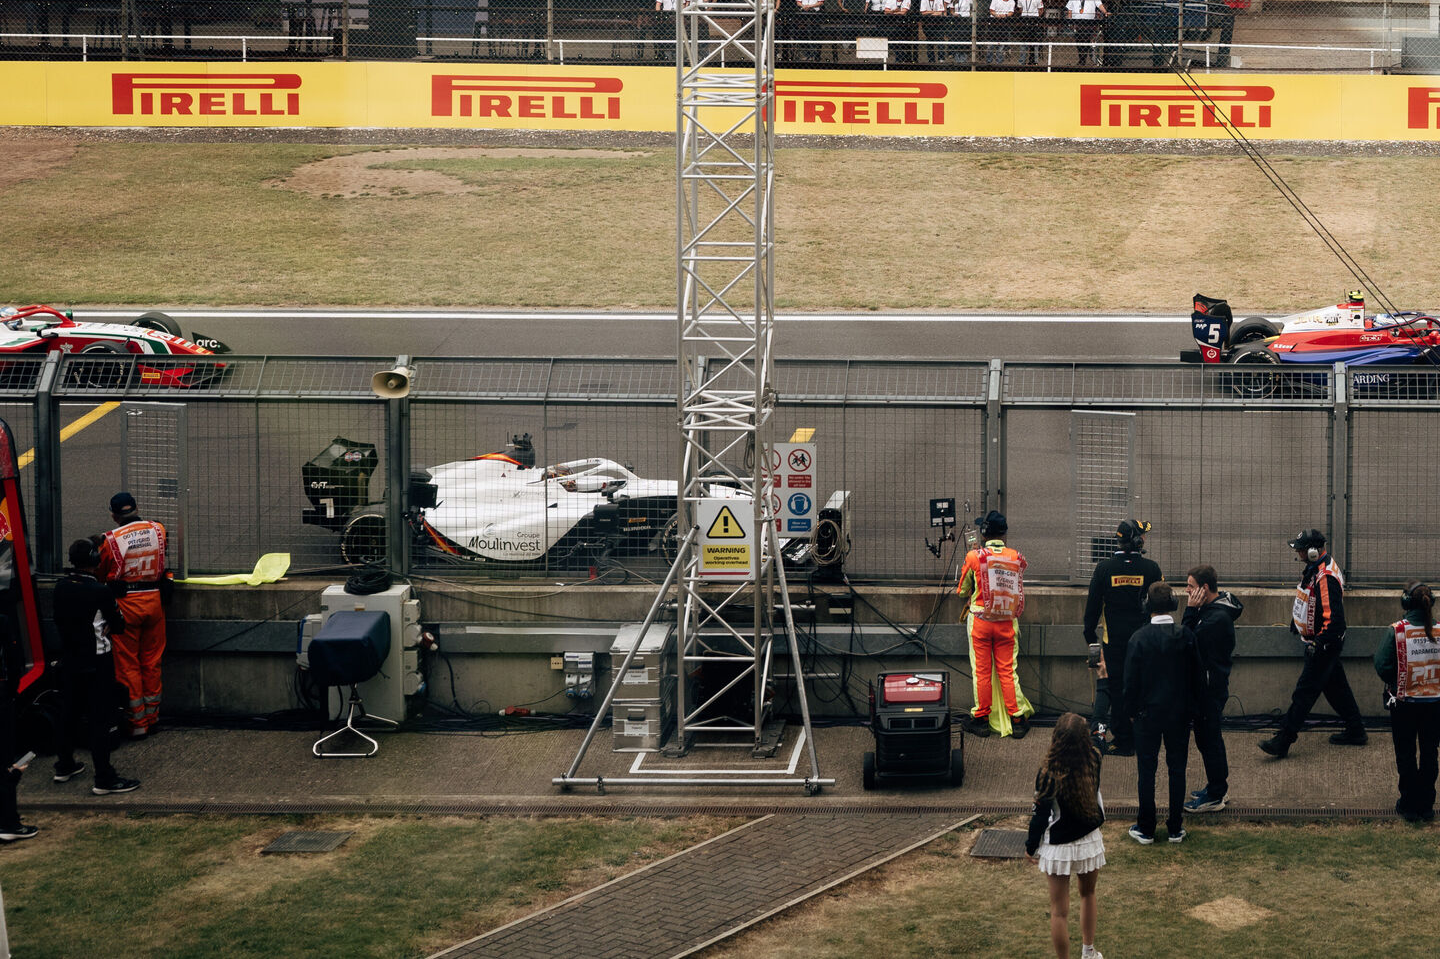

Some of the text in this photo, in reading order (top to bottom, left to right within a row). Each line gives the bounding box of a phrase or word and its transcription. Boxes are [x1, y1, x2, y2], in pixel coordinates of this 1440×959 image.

[111, 73, 302, 115] PIRELLI
[432, 75, 623, 119] PIRELLI
[1080, 84, 1275, 128] PIRELLI
[196, 338, 221, 349] arc.
[1208, 324, 1221, 344] 5
[468, 535, 541, 551] Moulinvest
[516, 531, 540, 539] Groupe
[1308, 596, 1316, 630] BRITAIN
